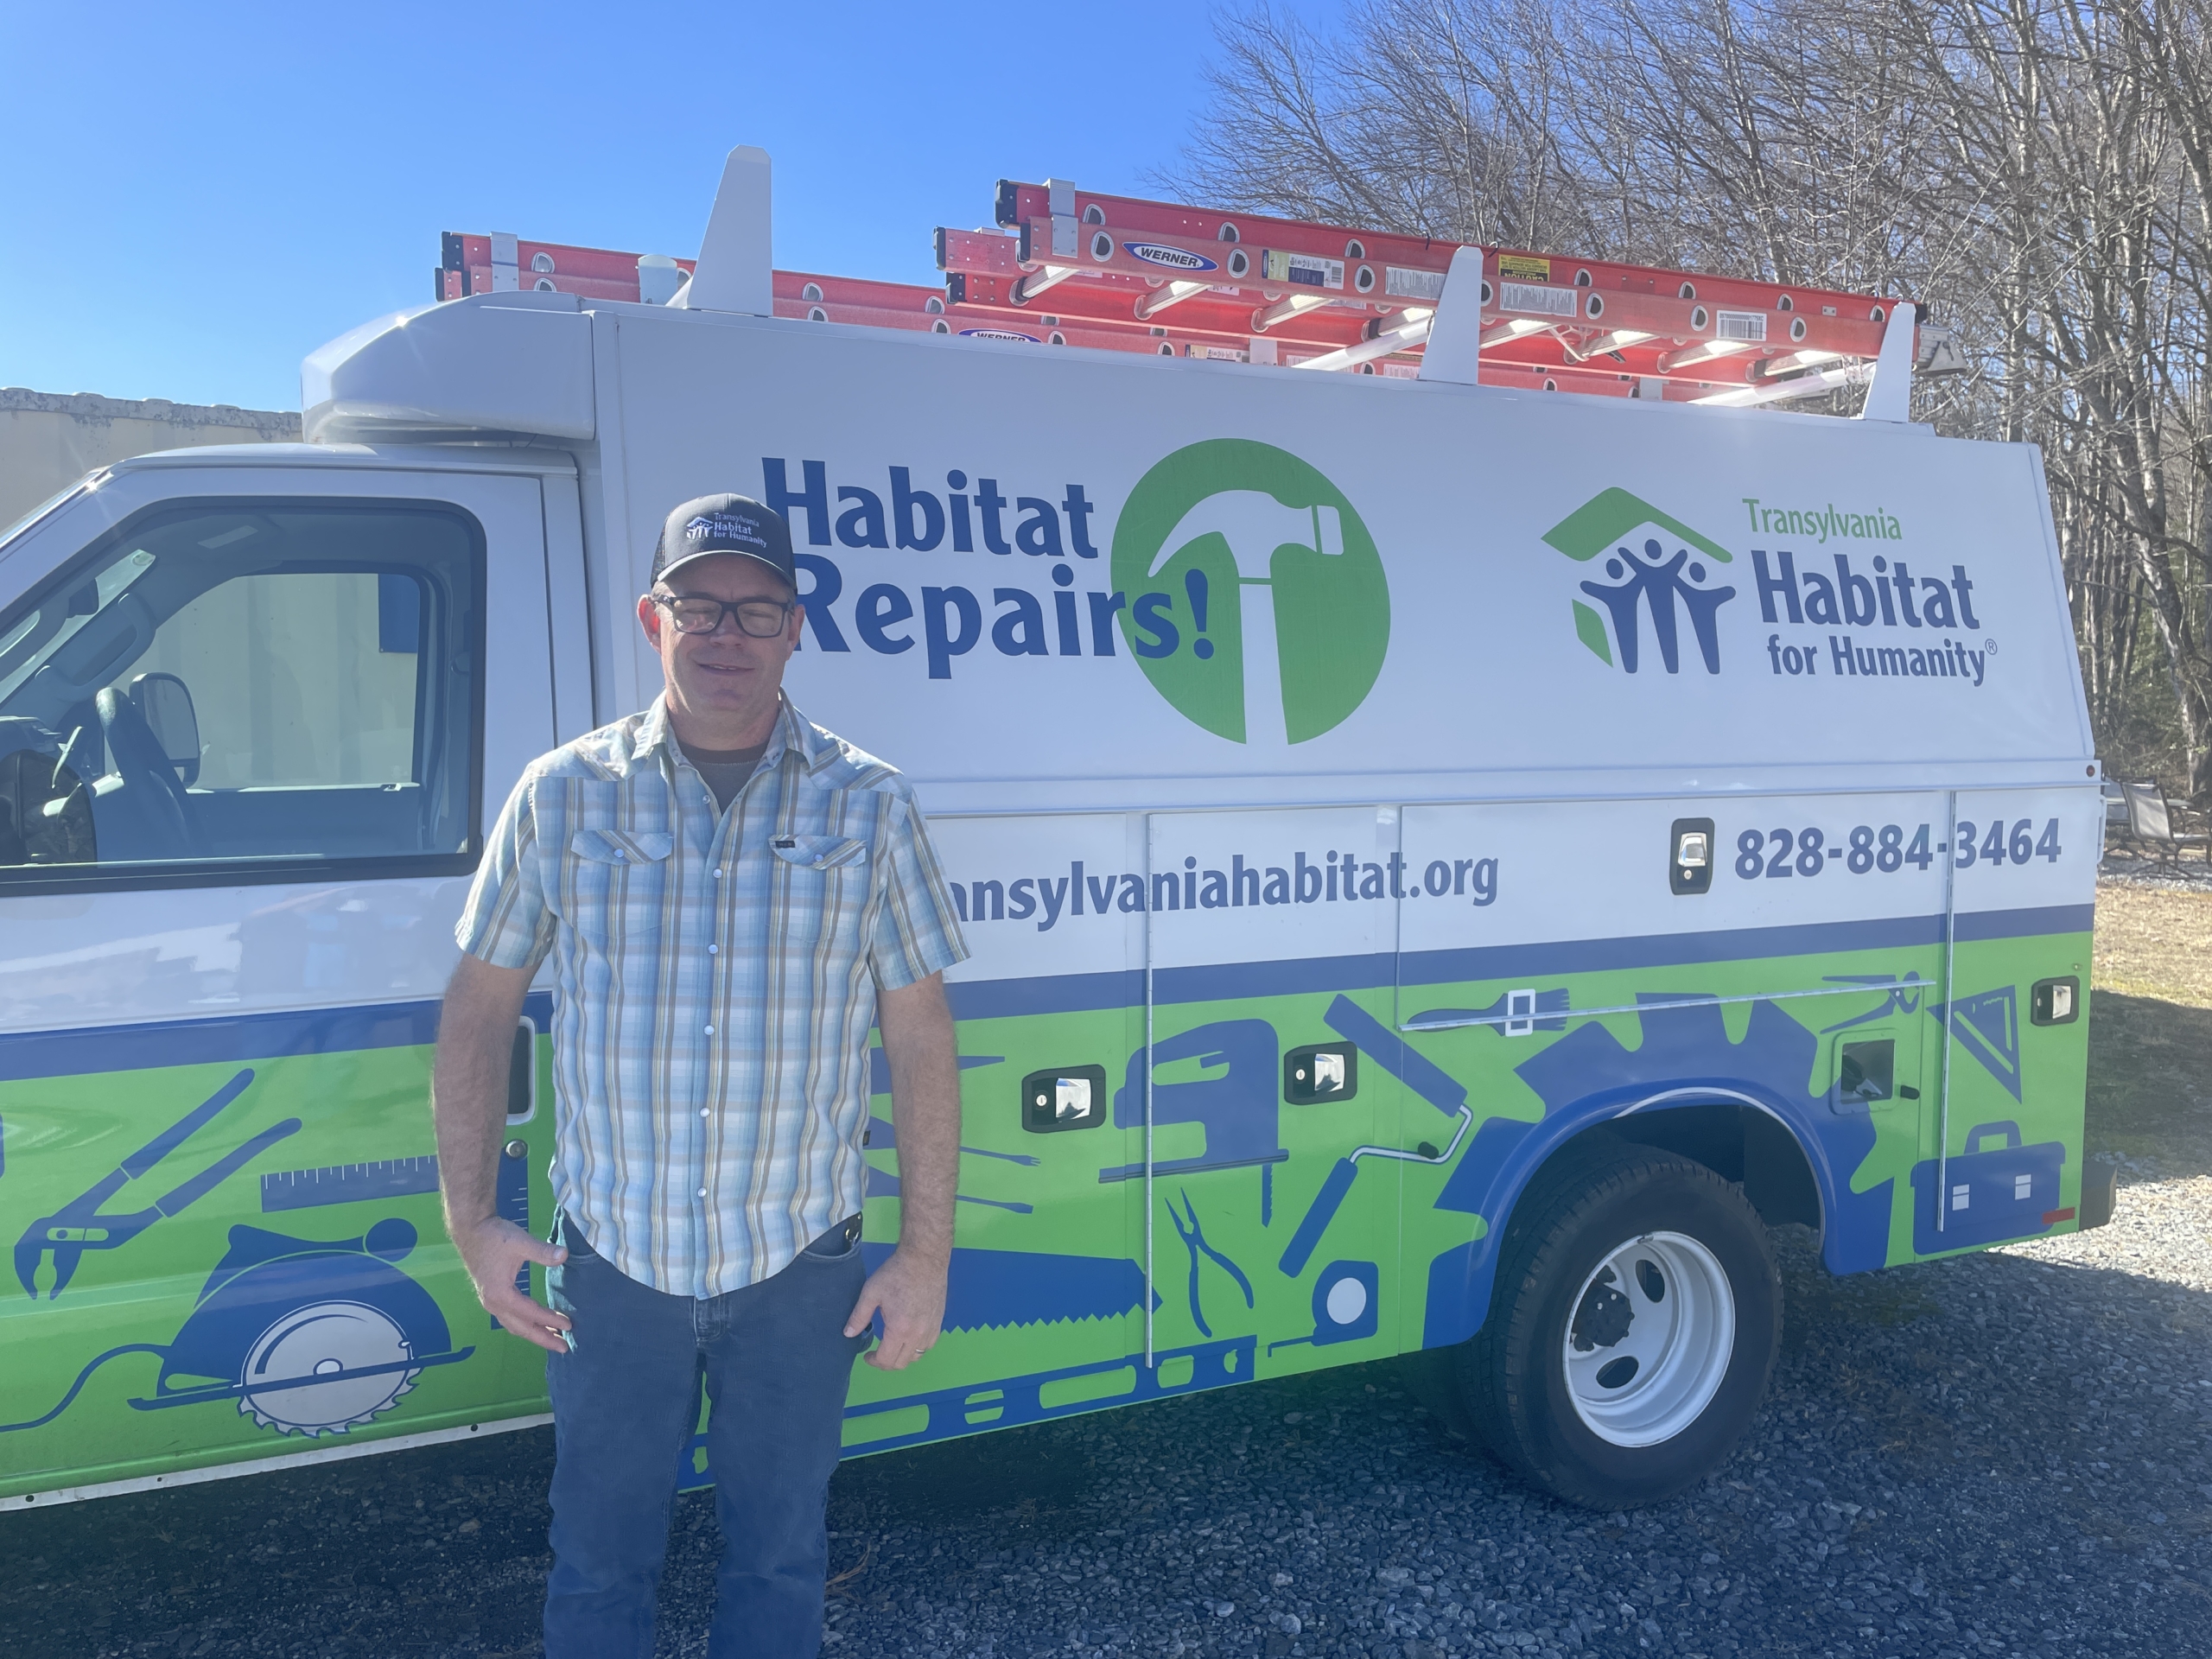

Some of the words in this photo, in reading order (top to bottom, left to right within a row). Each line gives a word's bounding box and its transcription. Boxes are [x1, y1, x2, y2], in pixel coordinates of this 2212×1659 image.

[1141, 247, 1198, 267] WERNER
[714, 512, 760, 528] Transylvania
[714, 521, 752, 535] Habitat
[761, 457, 1098, 559] Habitat
[1742, 498, 1903, 543] Transylvania
[729, 531, 767, 548] Humanity
[1751, 550, 1980, 630] Habitat
[792, 552, 1215, 680] Repairs!
[1767, 634, 1818, 675] for
[1735, 817, 2062, 880] 828-884-3464
